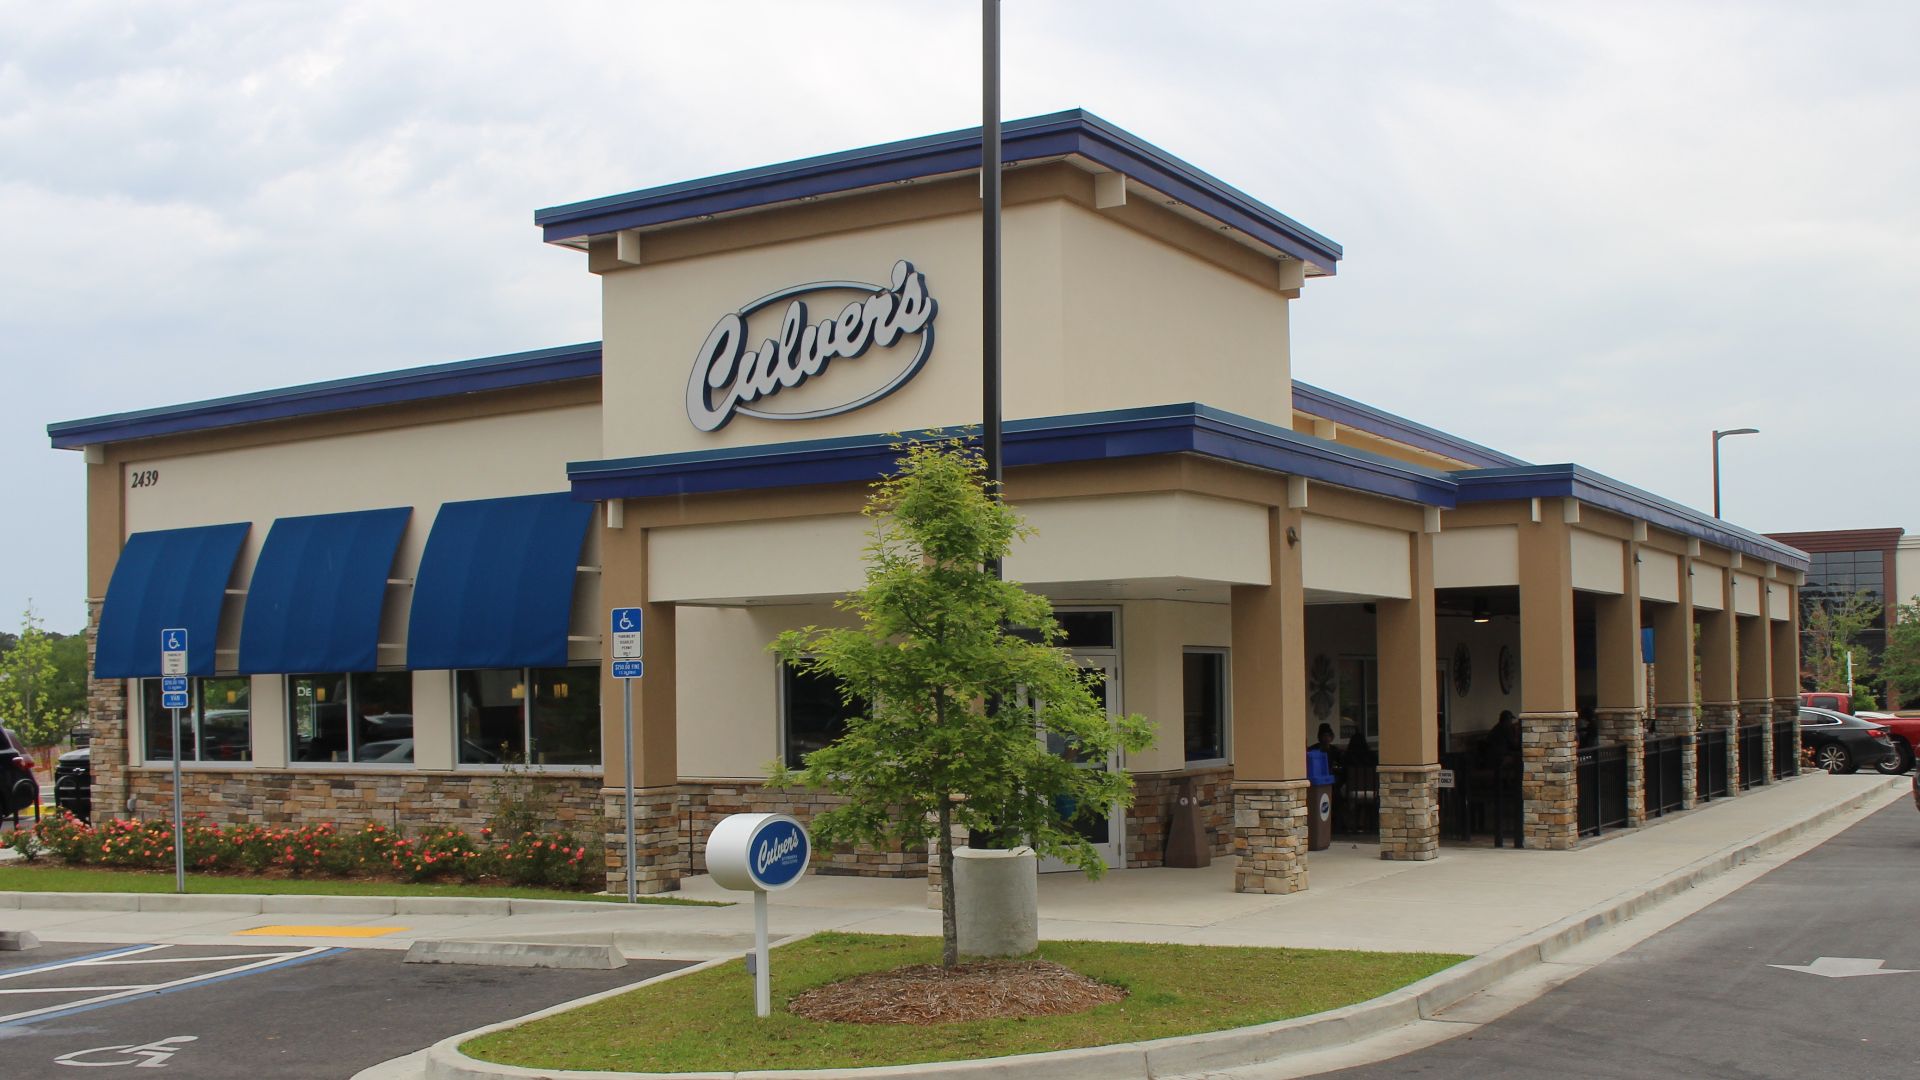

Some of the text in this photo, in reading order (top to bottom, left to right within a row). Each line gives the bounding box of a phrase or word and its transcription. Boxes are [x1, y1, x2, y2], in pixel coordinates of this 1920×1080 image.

[686, 258, 939, 433] Culver's
[131, 469, 159, 488] 2439
[757, 827, 799, 874] Culver's
